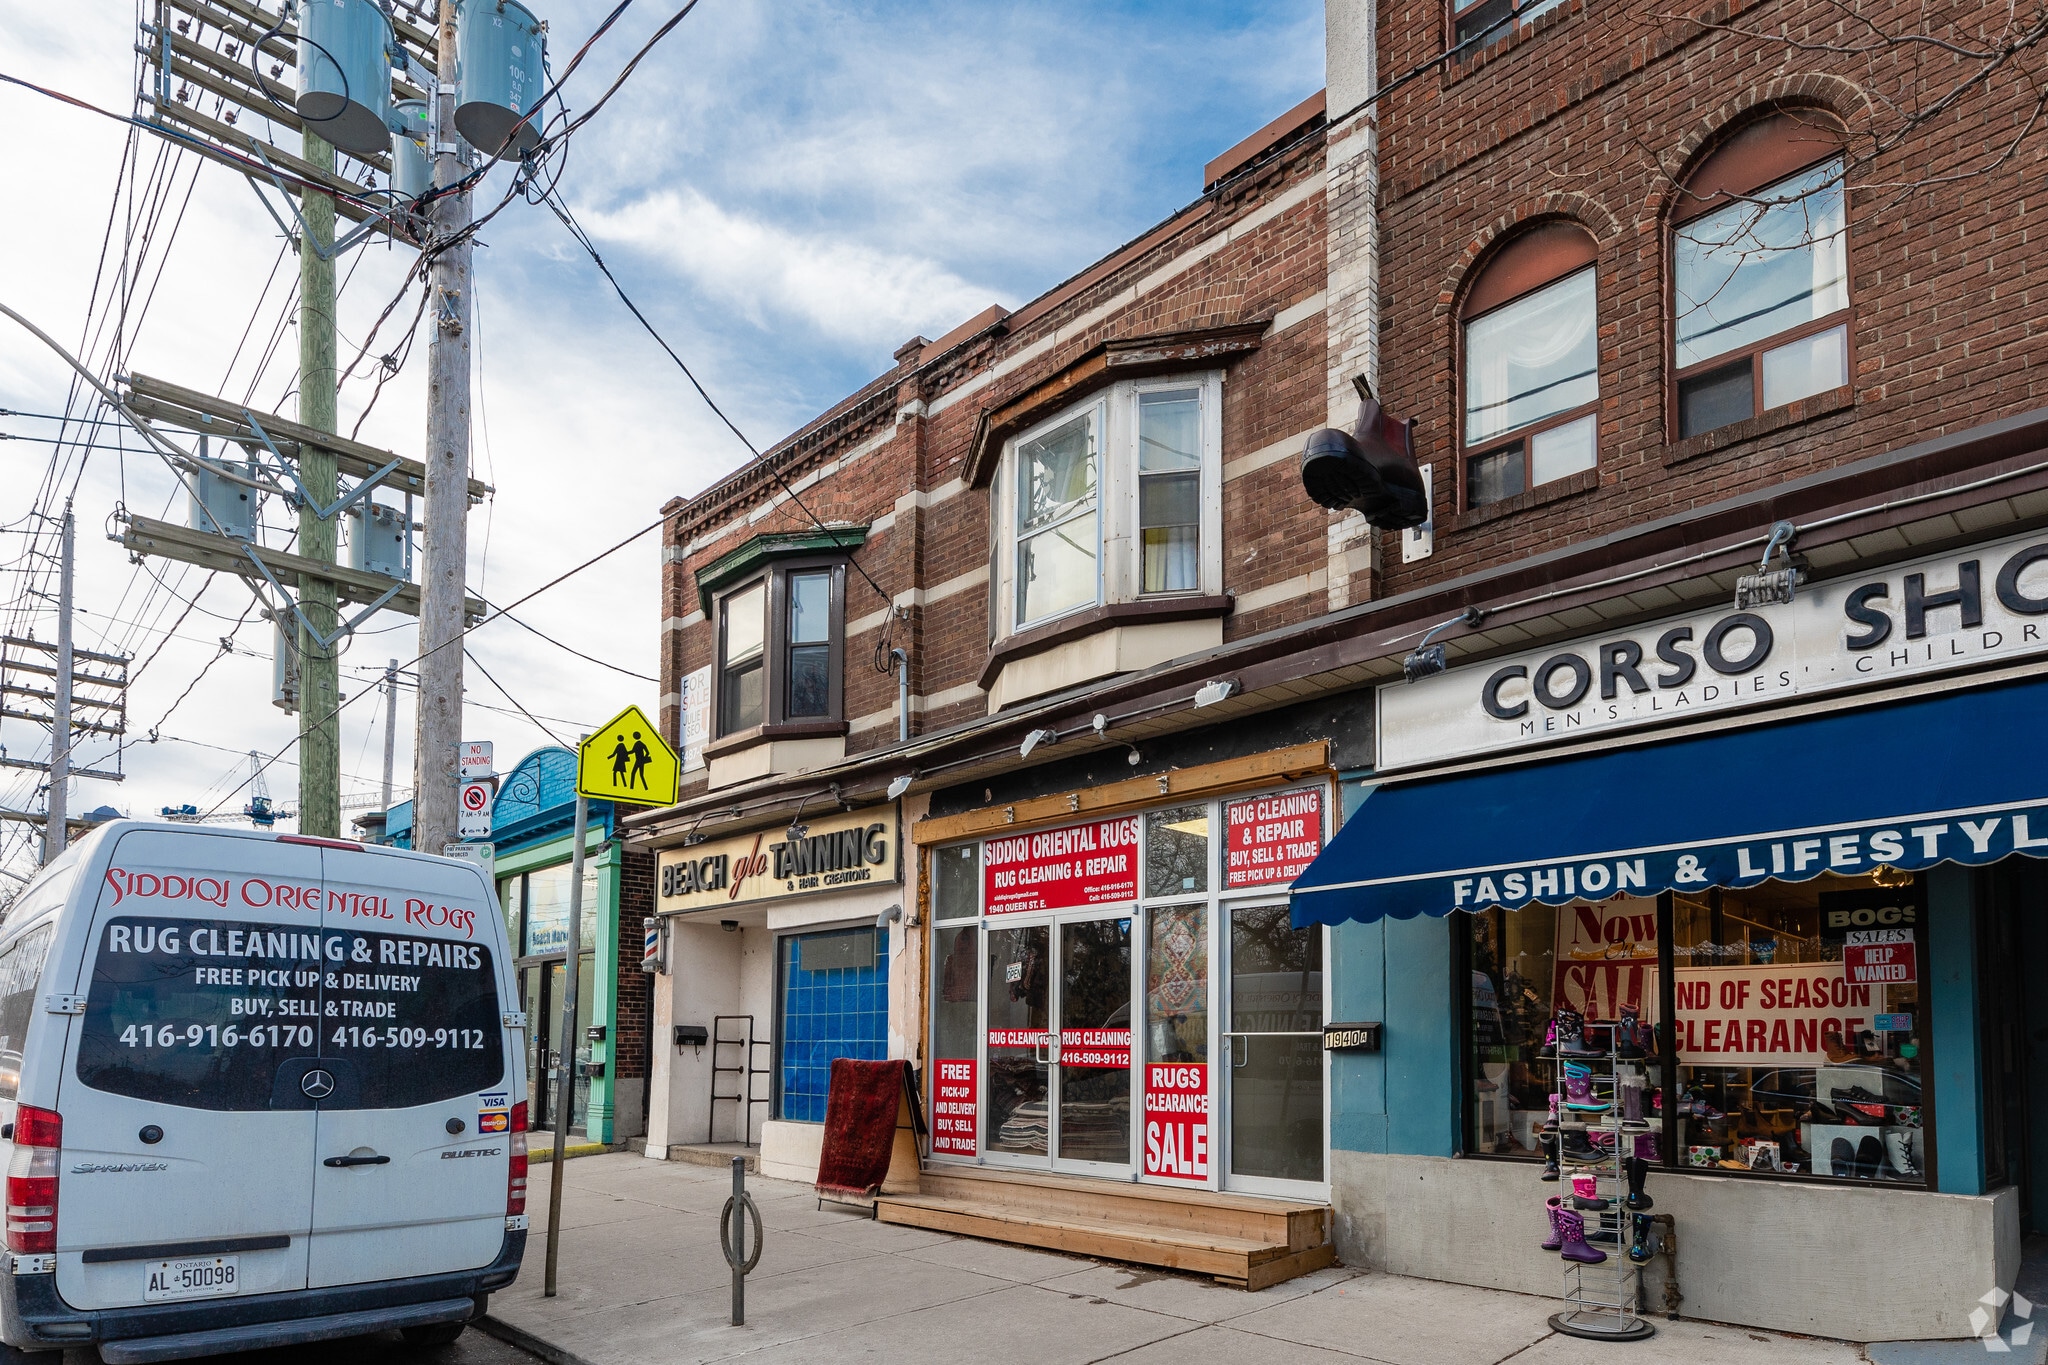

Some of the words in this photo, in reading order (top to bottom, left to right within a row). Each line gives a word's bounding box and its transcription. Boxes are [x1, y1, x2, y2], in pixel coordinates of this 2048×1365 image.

[492, 17, 503, 28] X2
[509, 64, 525, 83] 100
[512, 80, 522, 93] 8.0
[509, 90, 522, 104] 347
[1481, 613, 1774, 720] CORSO
[683, 672, 705, 695] FOR
[683, 687, 710, 711] SALE
[683, 709, 701, 727] JULIE
[1520, 704, 1618, 736] MEN'S
[687, 724, 701, 738] SEO
[470, 745, 482, 755] NO
[461, 756, 491, 766] STANDING
[460, 810, 466, 818] 7
[1230, 804, 1255, 826] RUG
[1257, 793, 1318, 821] CLEANING
[1242, 827, 1253, 845] &
[1256, 819, 1304, 843] REPAIR
[985, 836, 1029, 867] SIDDIQI
[1032, 825, 1097, 860] ORIENTAL
[1100, 817, 1139, 849] RUGS
[662, 853, 728, 898] BEACH
[728, 832, 768, 900] glo
[769, 823, 885, 880] TANNING
[1230, 850, 1250, 867] BUY,
[1252, 846, 1275, 864] SELL
[1276, 845, 1284, 861] &
[1286, 840, 1318, 860] TRADE
[1453, 859, 1647, 906] FASHION
[1674, 854, 1708, 884] &
[1737, 814, 2048, 878] LIFESTYL
[787, 880, 794, 891] &
[798, 876, 819, 889] HAIR
[823, 868, 871, 886] CREATIONS
[994, 870, 1017, 889] RUG
[1018, 863, 1072, 886] CLEANING
[1074, 860, 1083, 878] &
[1086, 854, 1128, 877] REPAIR
[1229, 871, 1247, 883] FREE
[1247, 868, 1264, 881] PICK
[1265, 867, 1275, 879] UP
[1276, 866, 1282, 878] &
[1100, 881, 1134, 892] 416-916-6170
[1100, 890, 1134, 900] 416-509-9112
[106, 867, 231, 909] SIDDIQI
[241, 878, 394, 919] ORIENTAL
[404, 898, 476, 940] RUGS
[989, 903, 1004, 914] 1940
[1005, 901, 1027, 912] QUEEN
[1028, 900, 1039, 909] ST.
[1851, 929, 1907, 944] SALES
[109, 925, 180, 954] RUG
[189, 928, 344, 962] CLEANING
[351, 937, 373, 963] &
[379, 939, 482, 970] REPAIRS
[1864, 948, 1894, 964] HELP
[195, 967, 243, 986] FREE
[248, 969, 291, 988] PICK
[295, 971, 320, 988] UP
[324, 972, 339, 989] &
[343, 973, 421, 992] DELIVERY
[1006, 967, 1021, 981] OPEN
[1854, 964, 1907, 982] WANTED
[1720, 979, 1750, 1010] OF
[1760, 977, 1870, 1010] SEASON
[231, 998, 274, 1018] BUY,
[278, 999, 319, 1017] SELL
[324, 1000, 338, 1017] &
[341, 1000, 396, 1018] TRADE
[119, 1024, 314, 1048] 416-916-6170
[331, 1026, 484, 1049] 416-509-9112
[989, 1031, 1006, 1045] RUG
[1007, 1031, 1050, 1046] CLEANING
[1062, 1031, 1081, 1046] RUG
[1083, 1031, 1131, 1046] CLEANING
[1062, 1052, 1129, 1065] 416-509-9112
[941, 1063, 971, 1080] FREE
[1152, 1067, 1201, 1089] RUGS
[941, 1086, 970, 1098] PICK-UP
[483, 1098, 505, 1107] VISA
[935, 1101, 948, 1114] AND
[948, 1102, 976, 1115] DELIVERY
[1145, 1092, 1208, 1114] CLEARANCE
[481, 1119, 507, 1127] MasterCard
[937, 1118, 954, 1133] BUY,
[954, 1119, 973, 1132] SELL
[935, 1137, 950, 1149] AND
[951, 1138, 976, 1151] TRADE
[1146, 1120, 1208, 1176] SALE
[70, 1162, 168, 1174] SPRINTER
[174, 1260, 212, 1270] ONTARIO
[148, 1272, 170, 1292] AL
[182, 1265, 235, 1288] 50098
